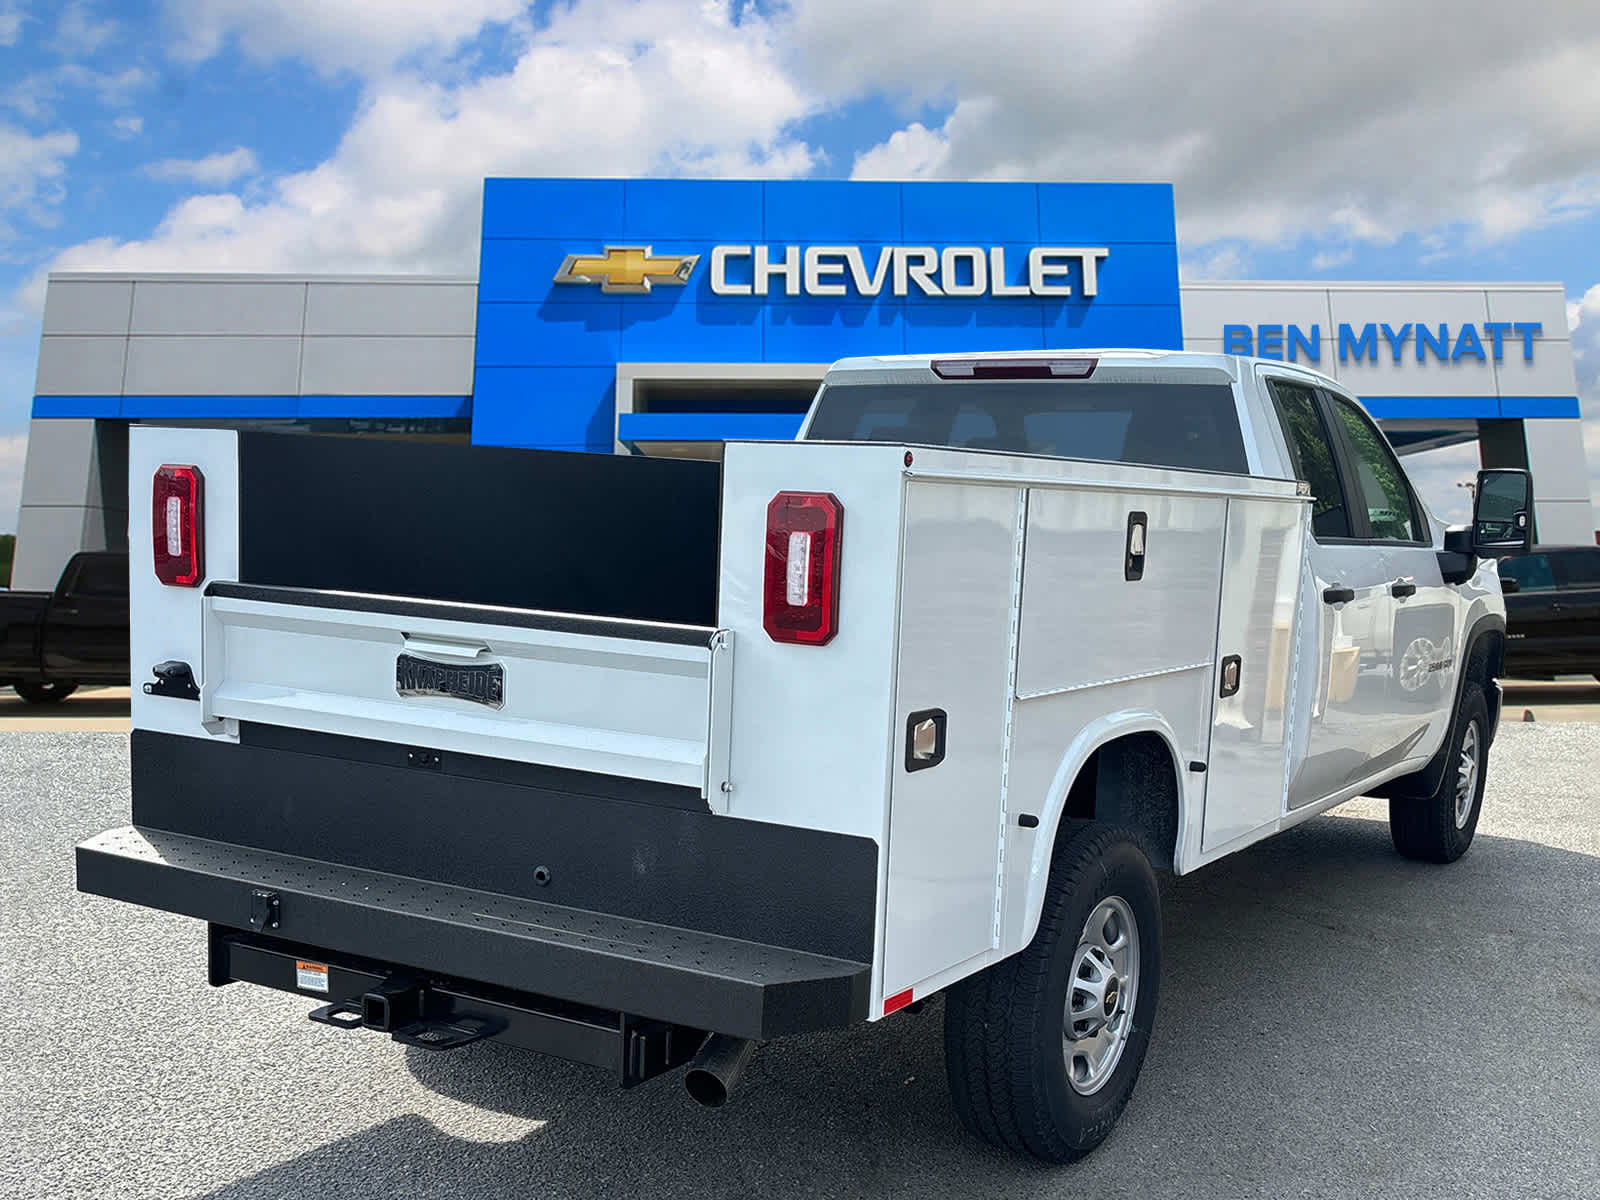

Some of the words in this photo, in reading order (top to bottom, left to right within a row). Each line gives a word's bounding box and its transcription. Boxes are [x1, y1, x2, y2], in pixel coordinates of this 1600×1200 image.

[711, 245, 1109, 296] CHEVROLET
[1223, 324, 1320, 361] BEN
[1338, 322, 1542, 361] MYNATT
